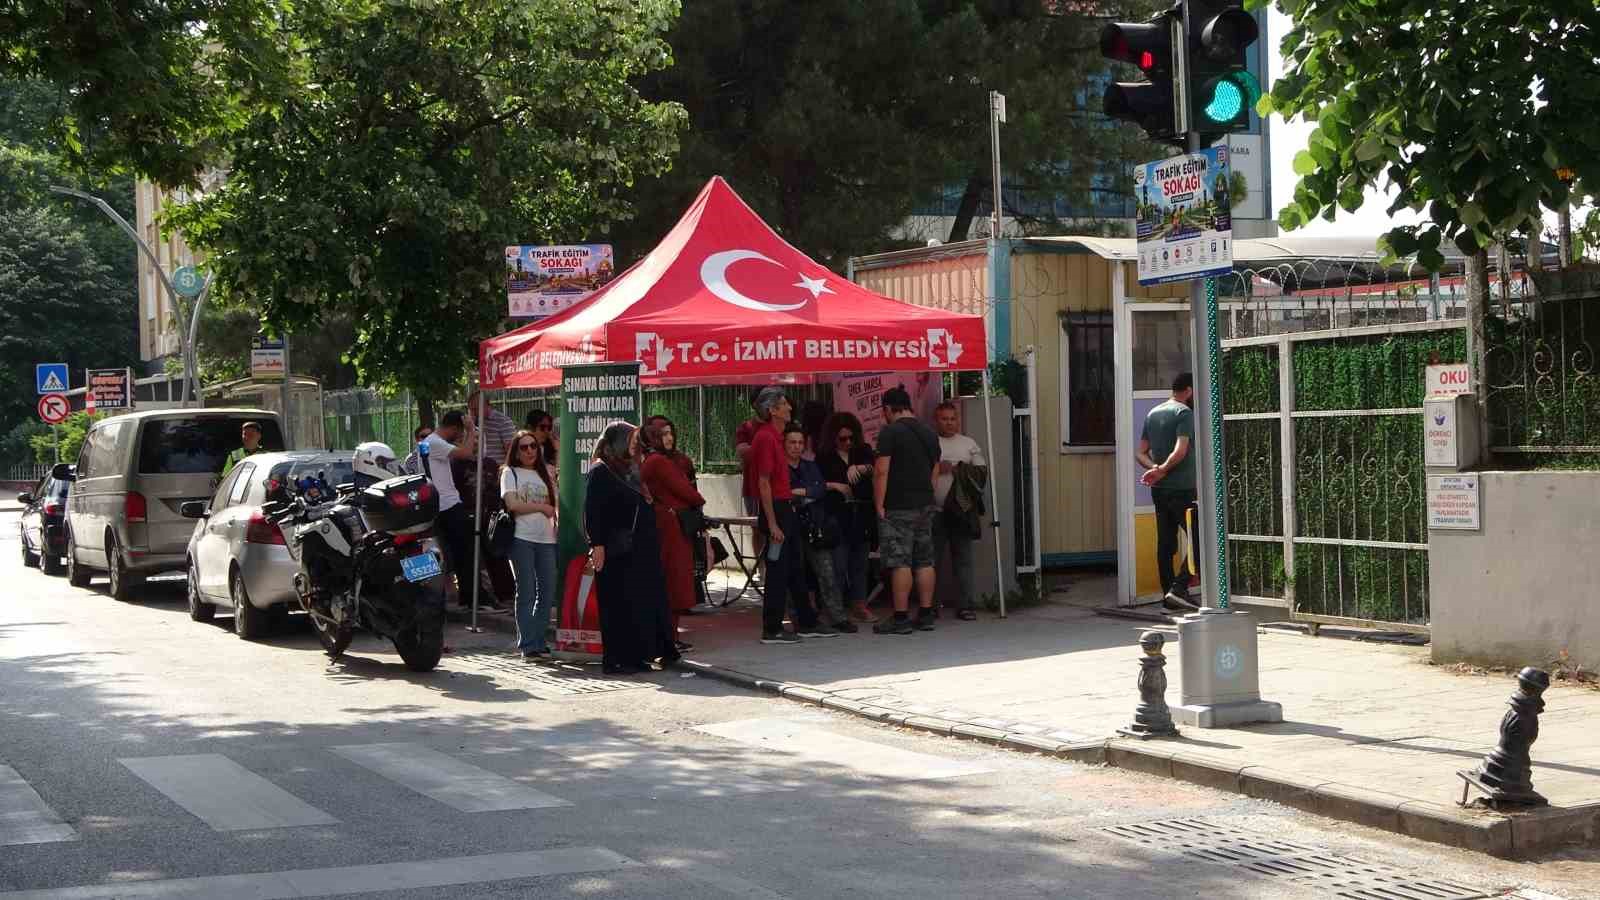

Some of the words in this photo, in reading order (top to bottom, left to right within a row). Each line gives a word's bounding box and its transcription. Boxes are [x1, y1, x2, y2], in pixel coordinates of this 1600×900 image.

[1155, 164, 1181, 182] TRAFİK
[1183, 158, 1207, 177] EĞİTİM
[532, 249, 560, 259] TRAFİK
[562, 248, 589, 258] EĞİTİM
[676, 341, 728, 363] T.C.
[734, 335, 798, 360] İZMİT
[805, 335, 927, 359] BELEDİYESİ
[564, 376, 598, 393] SINAVA
[599, 373, 638, 391] GİRECEK
[566, 396, 587, 413] TÜM
[588, 395, 635, 412] ADAYLARA
